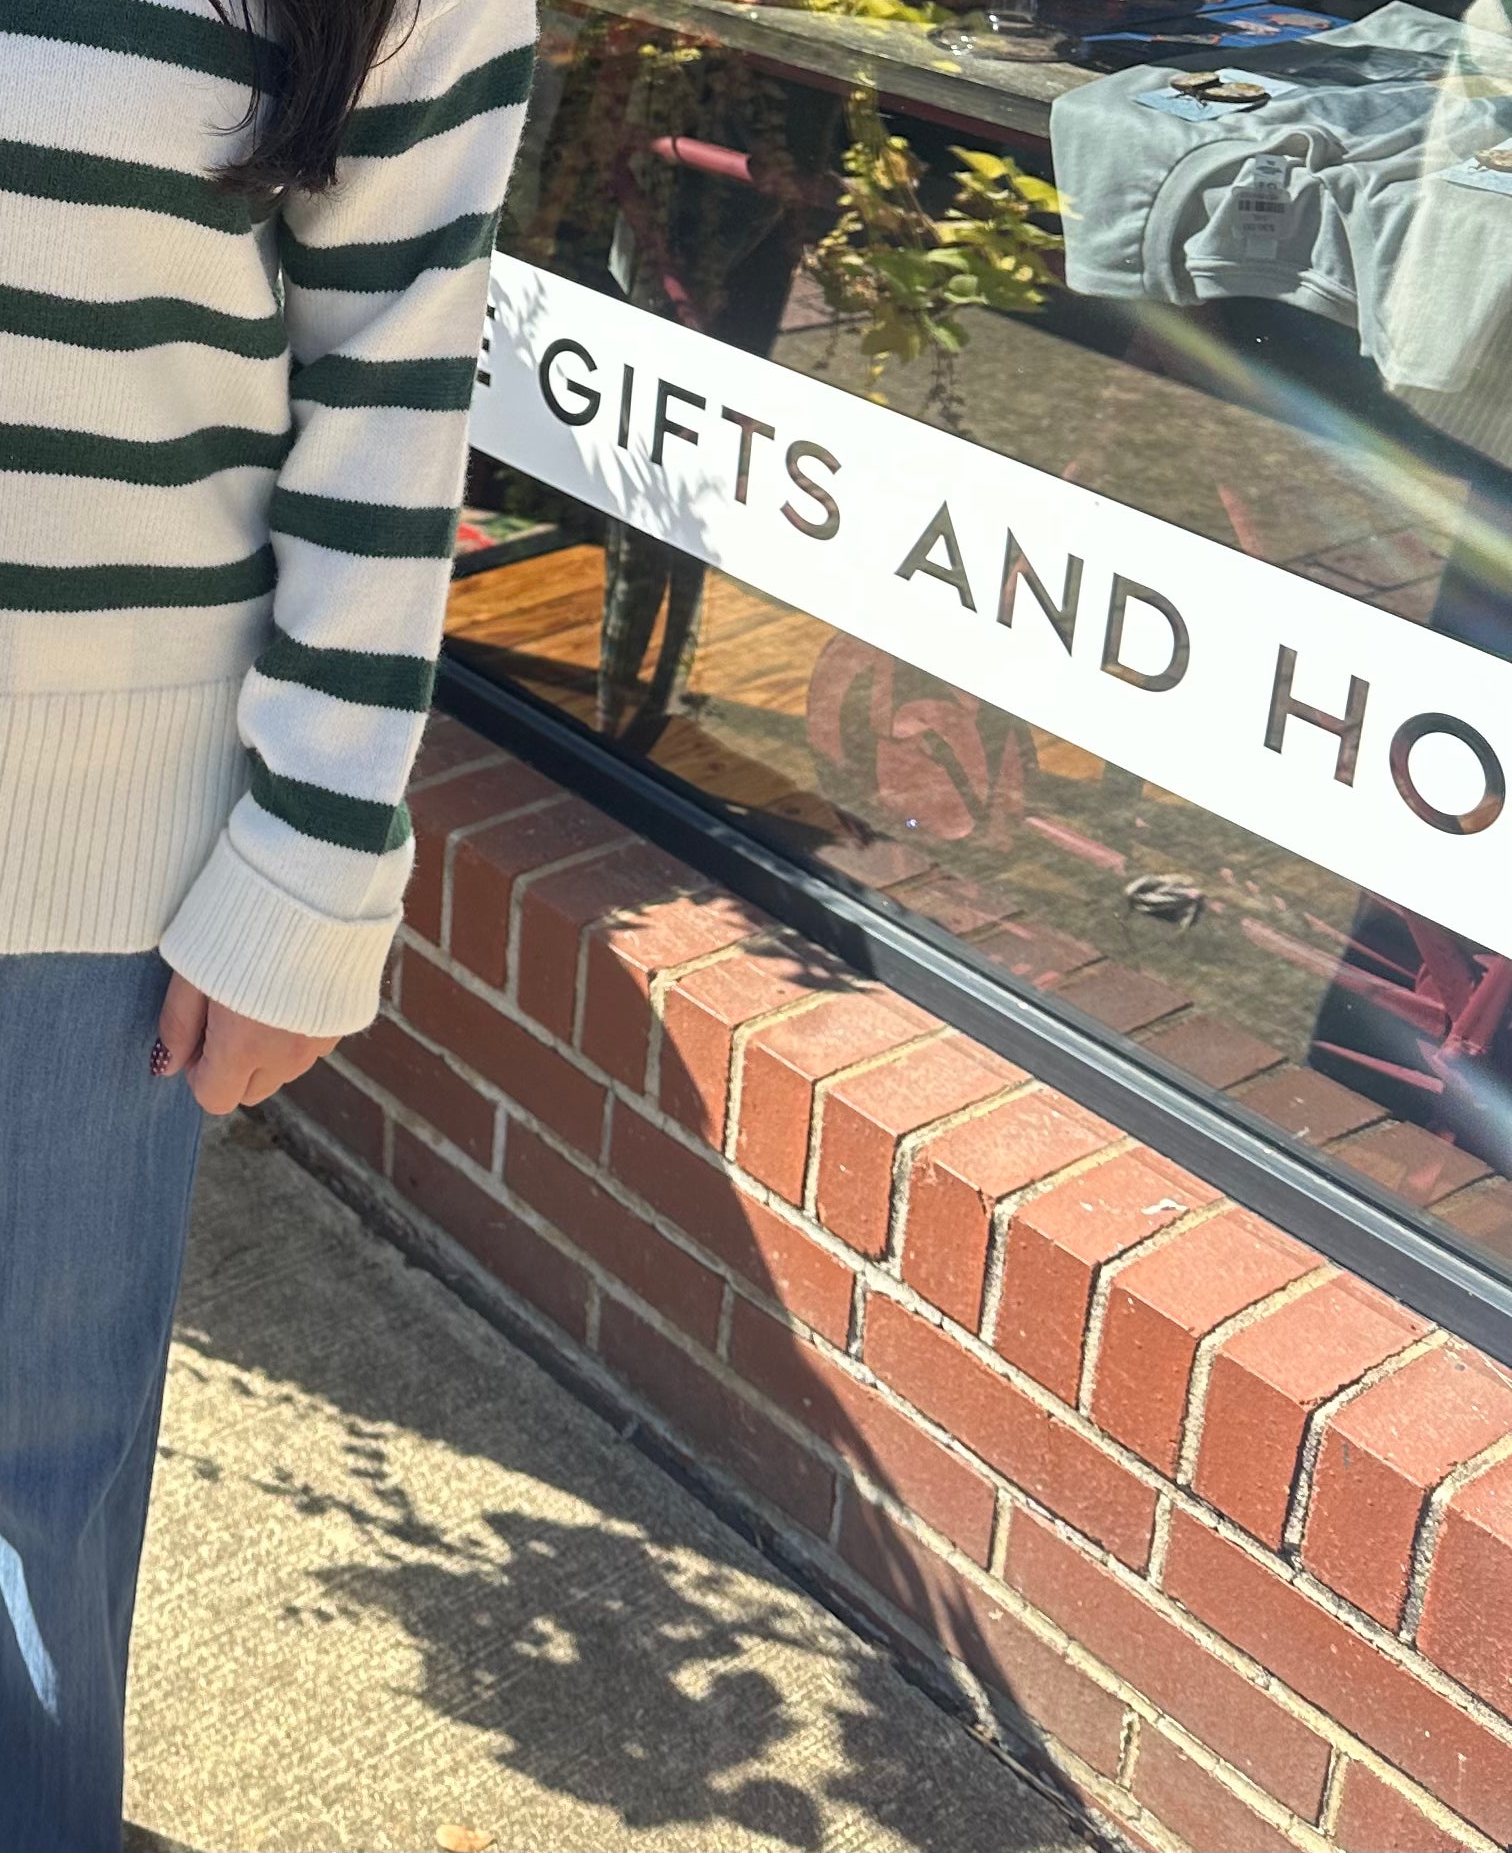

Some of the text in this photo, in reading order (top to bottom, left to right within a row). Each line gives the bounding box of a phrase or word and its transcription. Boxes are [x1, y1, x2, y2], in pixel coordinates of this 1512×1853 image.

[539, 338, 842, 541] GIFTS
[893, 500, 1191, 693] AND
[1263, 643, 1506, 836] HO
